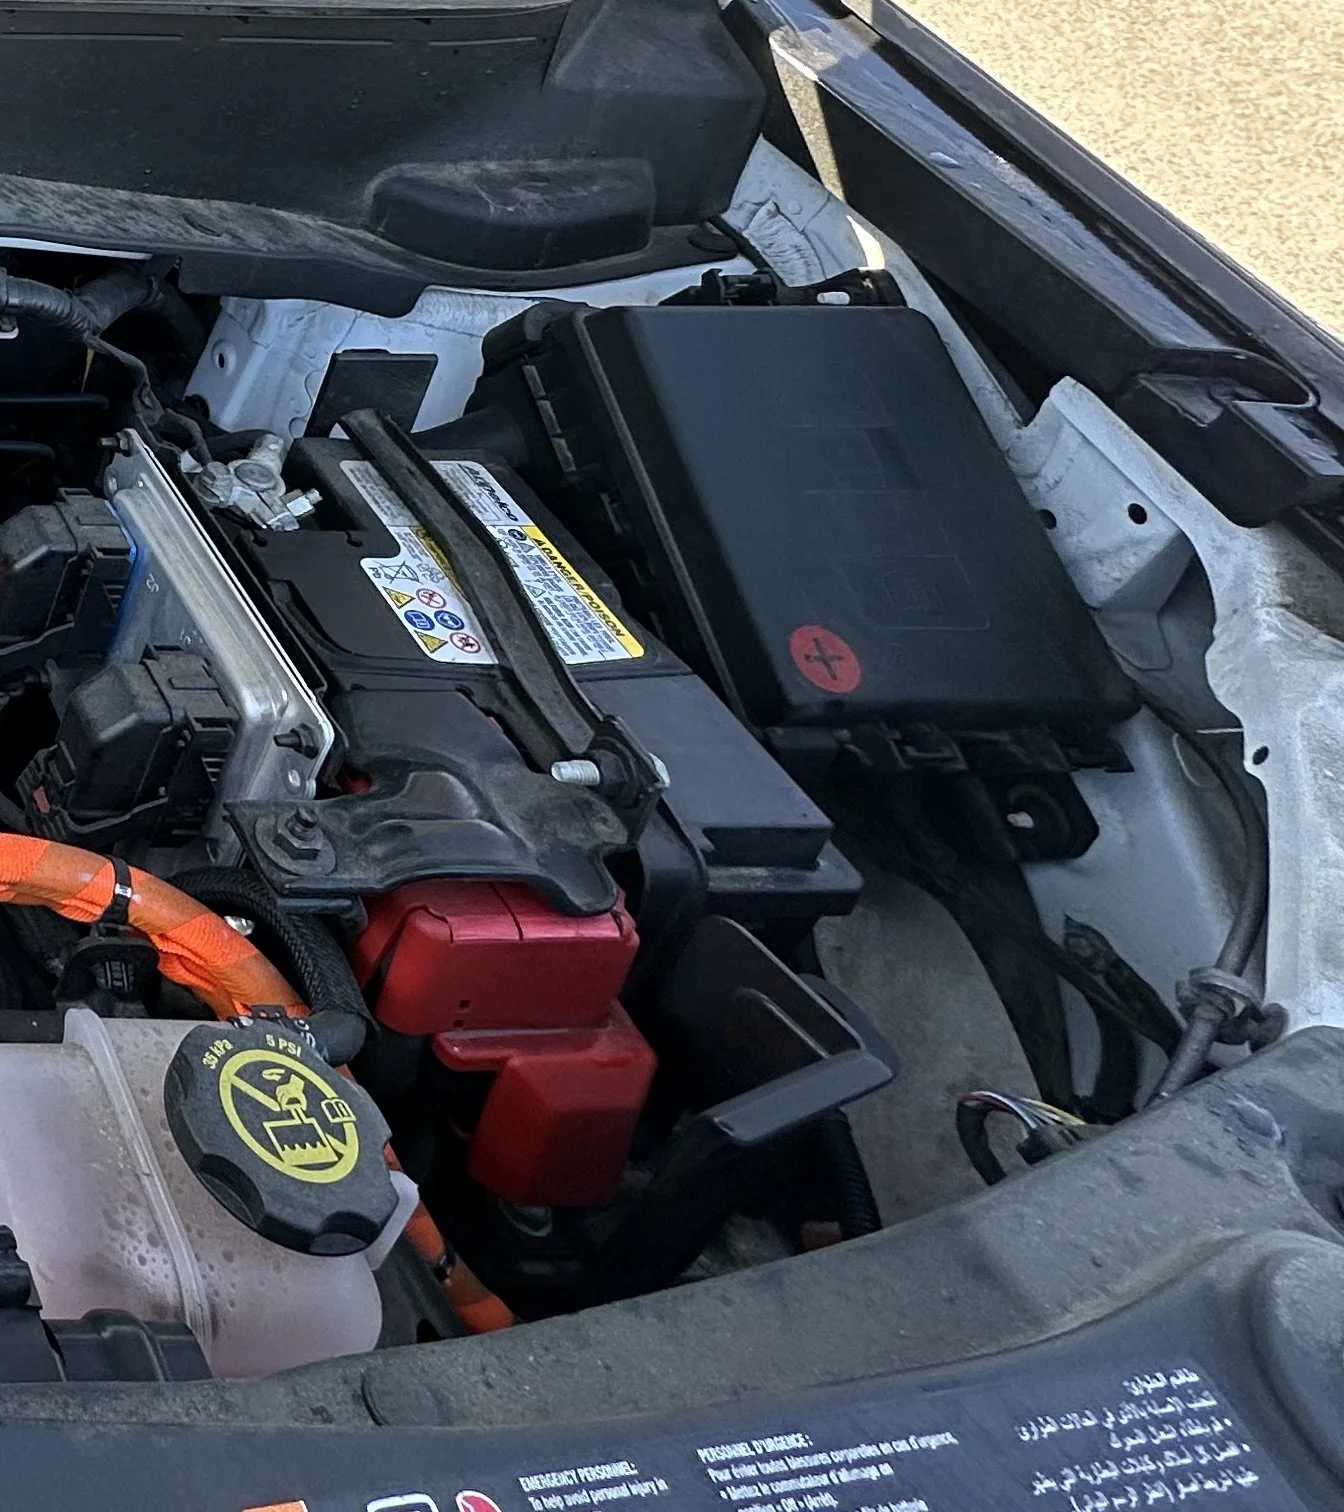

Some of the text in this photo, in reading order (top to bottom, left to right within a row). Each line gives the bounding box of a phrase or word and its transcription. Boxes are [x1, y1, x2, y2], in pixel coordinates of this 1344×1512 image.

[543, 547, 626, 637] DANGER/POISON
[278, 1037, 302, 1057] PSI
[697, 1441, 753, 1465] PERSONNEL
[751, 1433, 807, 1455] D'URGENCE
[519, 1460, 639, 1493] EMERGENCY PERSONNEL:
[707, 1467, 733, 1484] Pour
[785, 1451, 832, 1470] blessures
[528, 1496, 543, 1511] To
[541, 1493, 565, 1510] help
[564, 1489, 591, 1506] avoid
[588, 1483, 631, 1504] personal
[627, 1479, 660, 1497] injury
